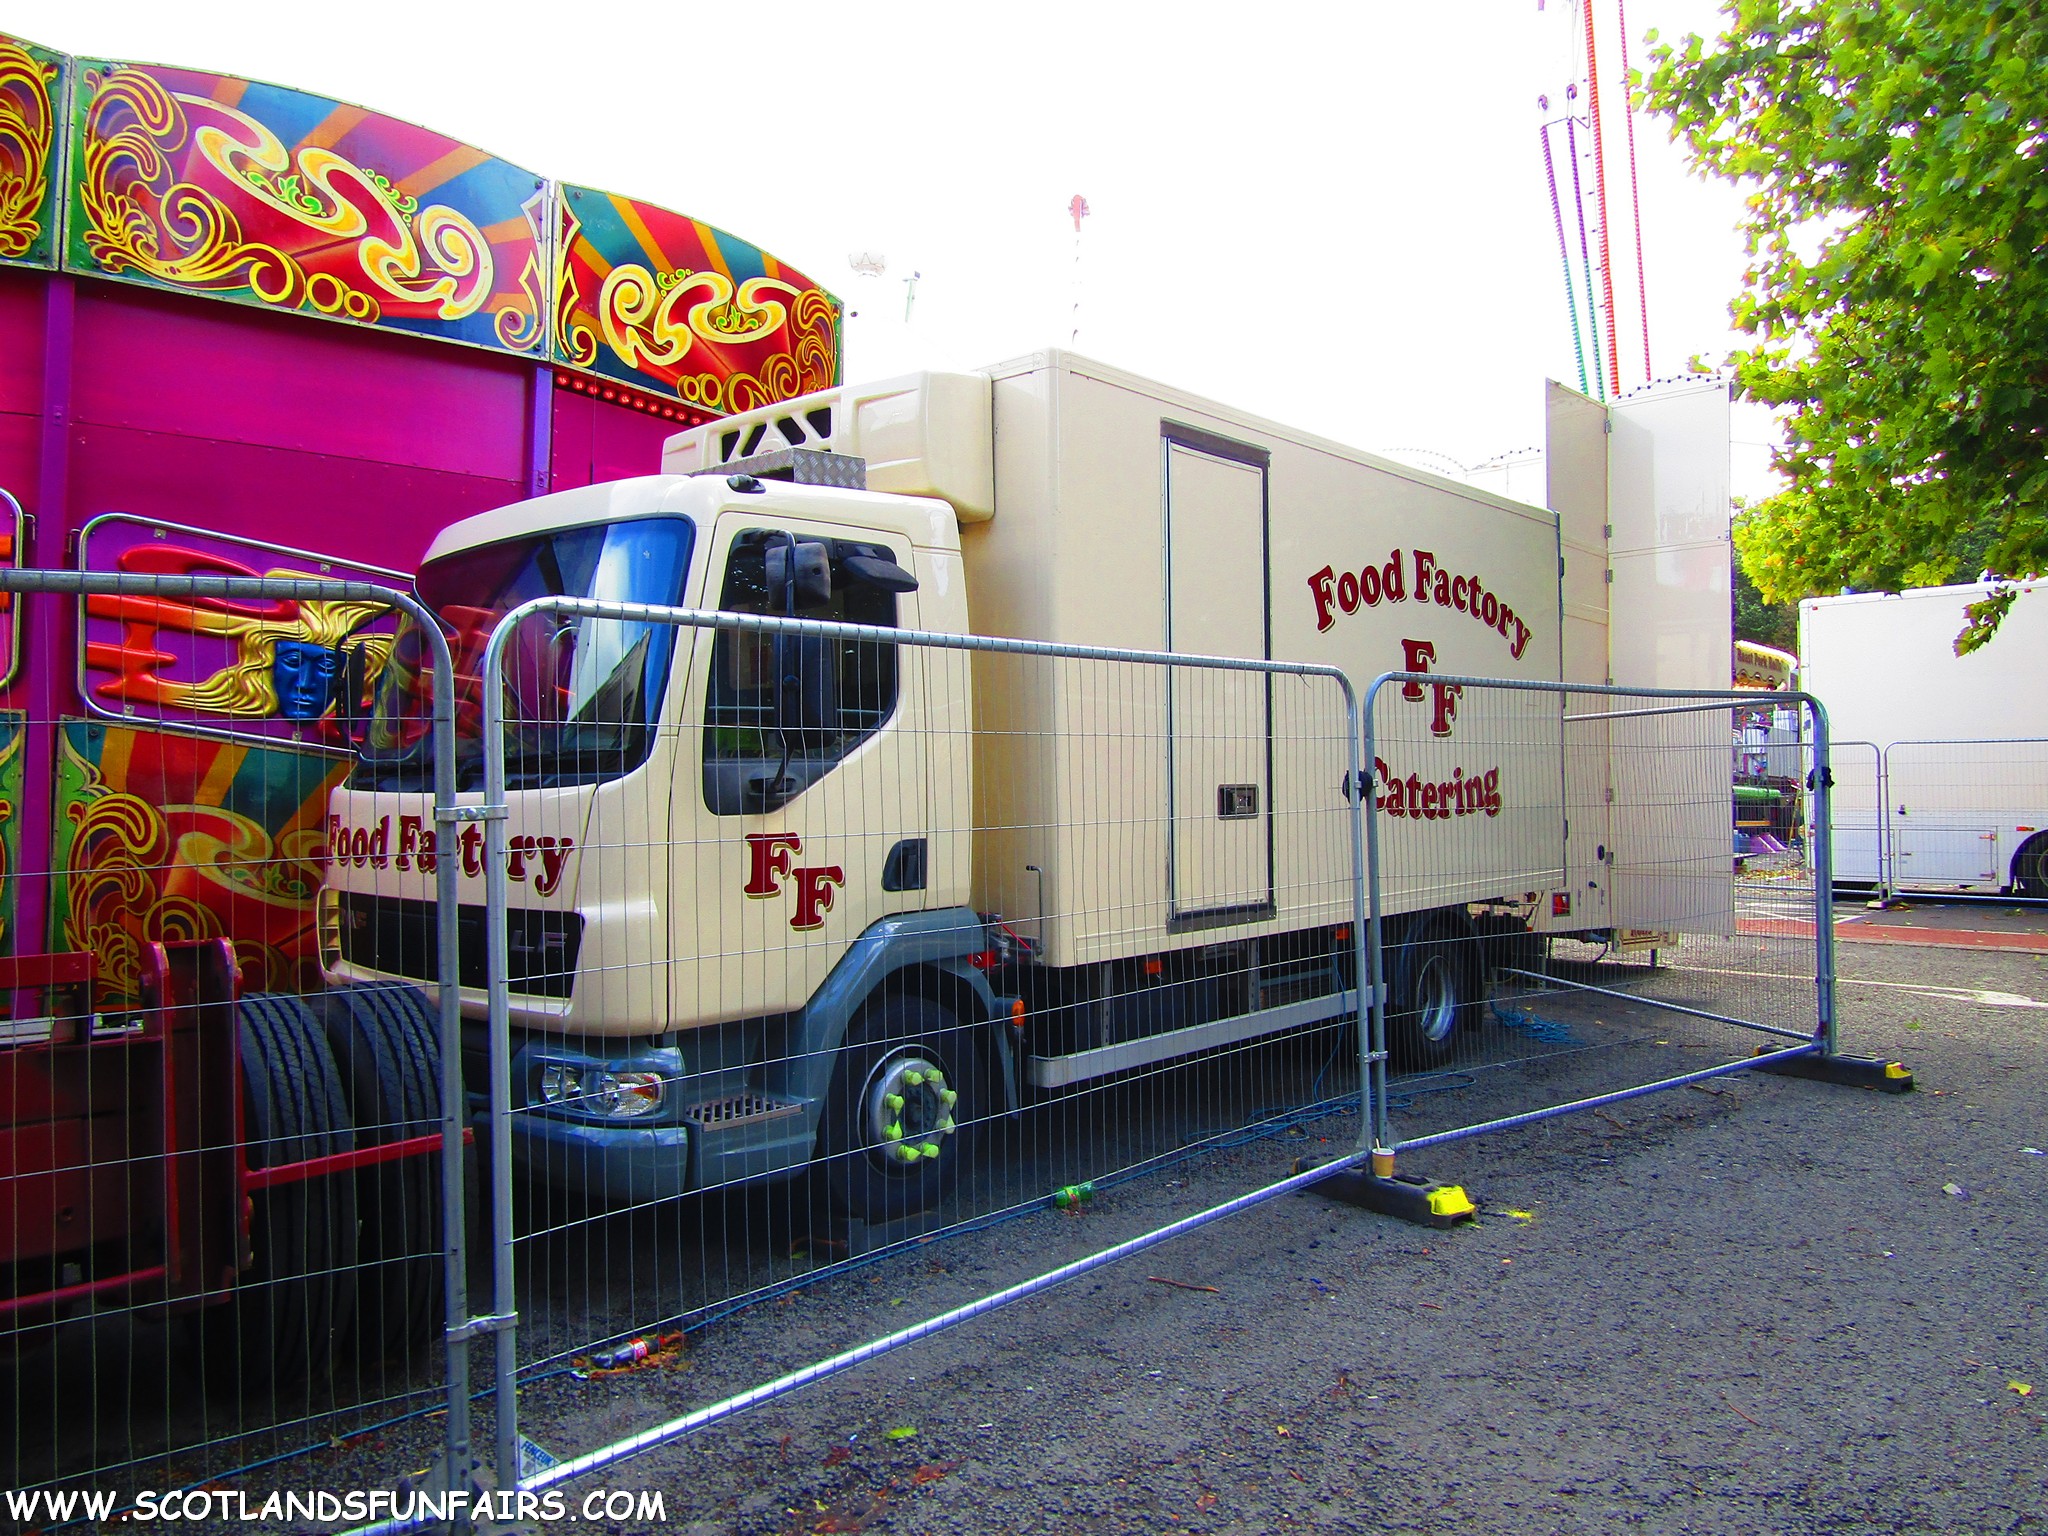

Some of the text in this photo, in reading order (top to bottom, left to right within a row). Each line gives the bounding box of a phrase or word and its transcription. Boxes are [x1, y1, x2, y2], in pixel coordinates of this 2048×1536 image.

[1307, 548, 1533, 660] Food Factory
[1373, 756, 1502, 820] Catering
[327, 814, 574, 897] Food Fatry
[511, 930, 568, 952] LF
